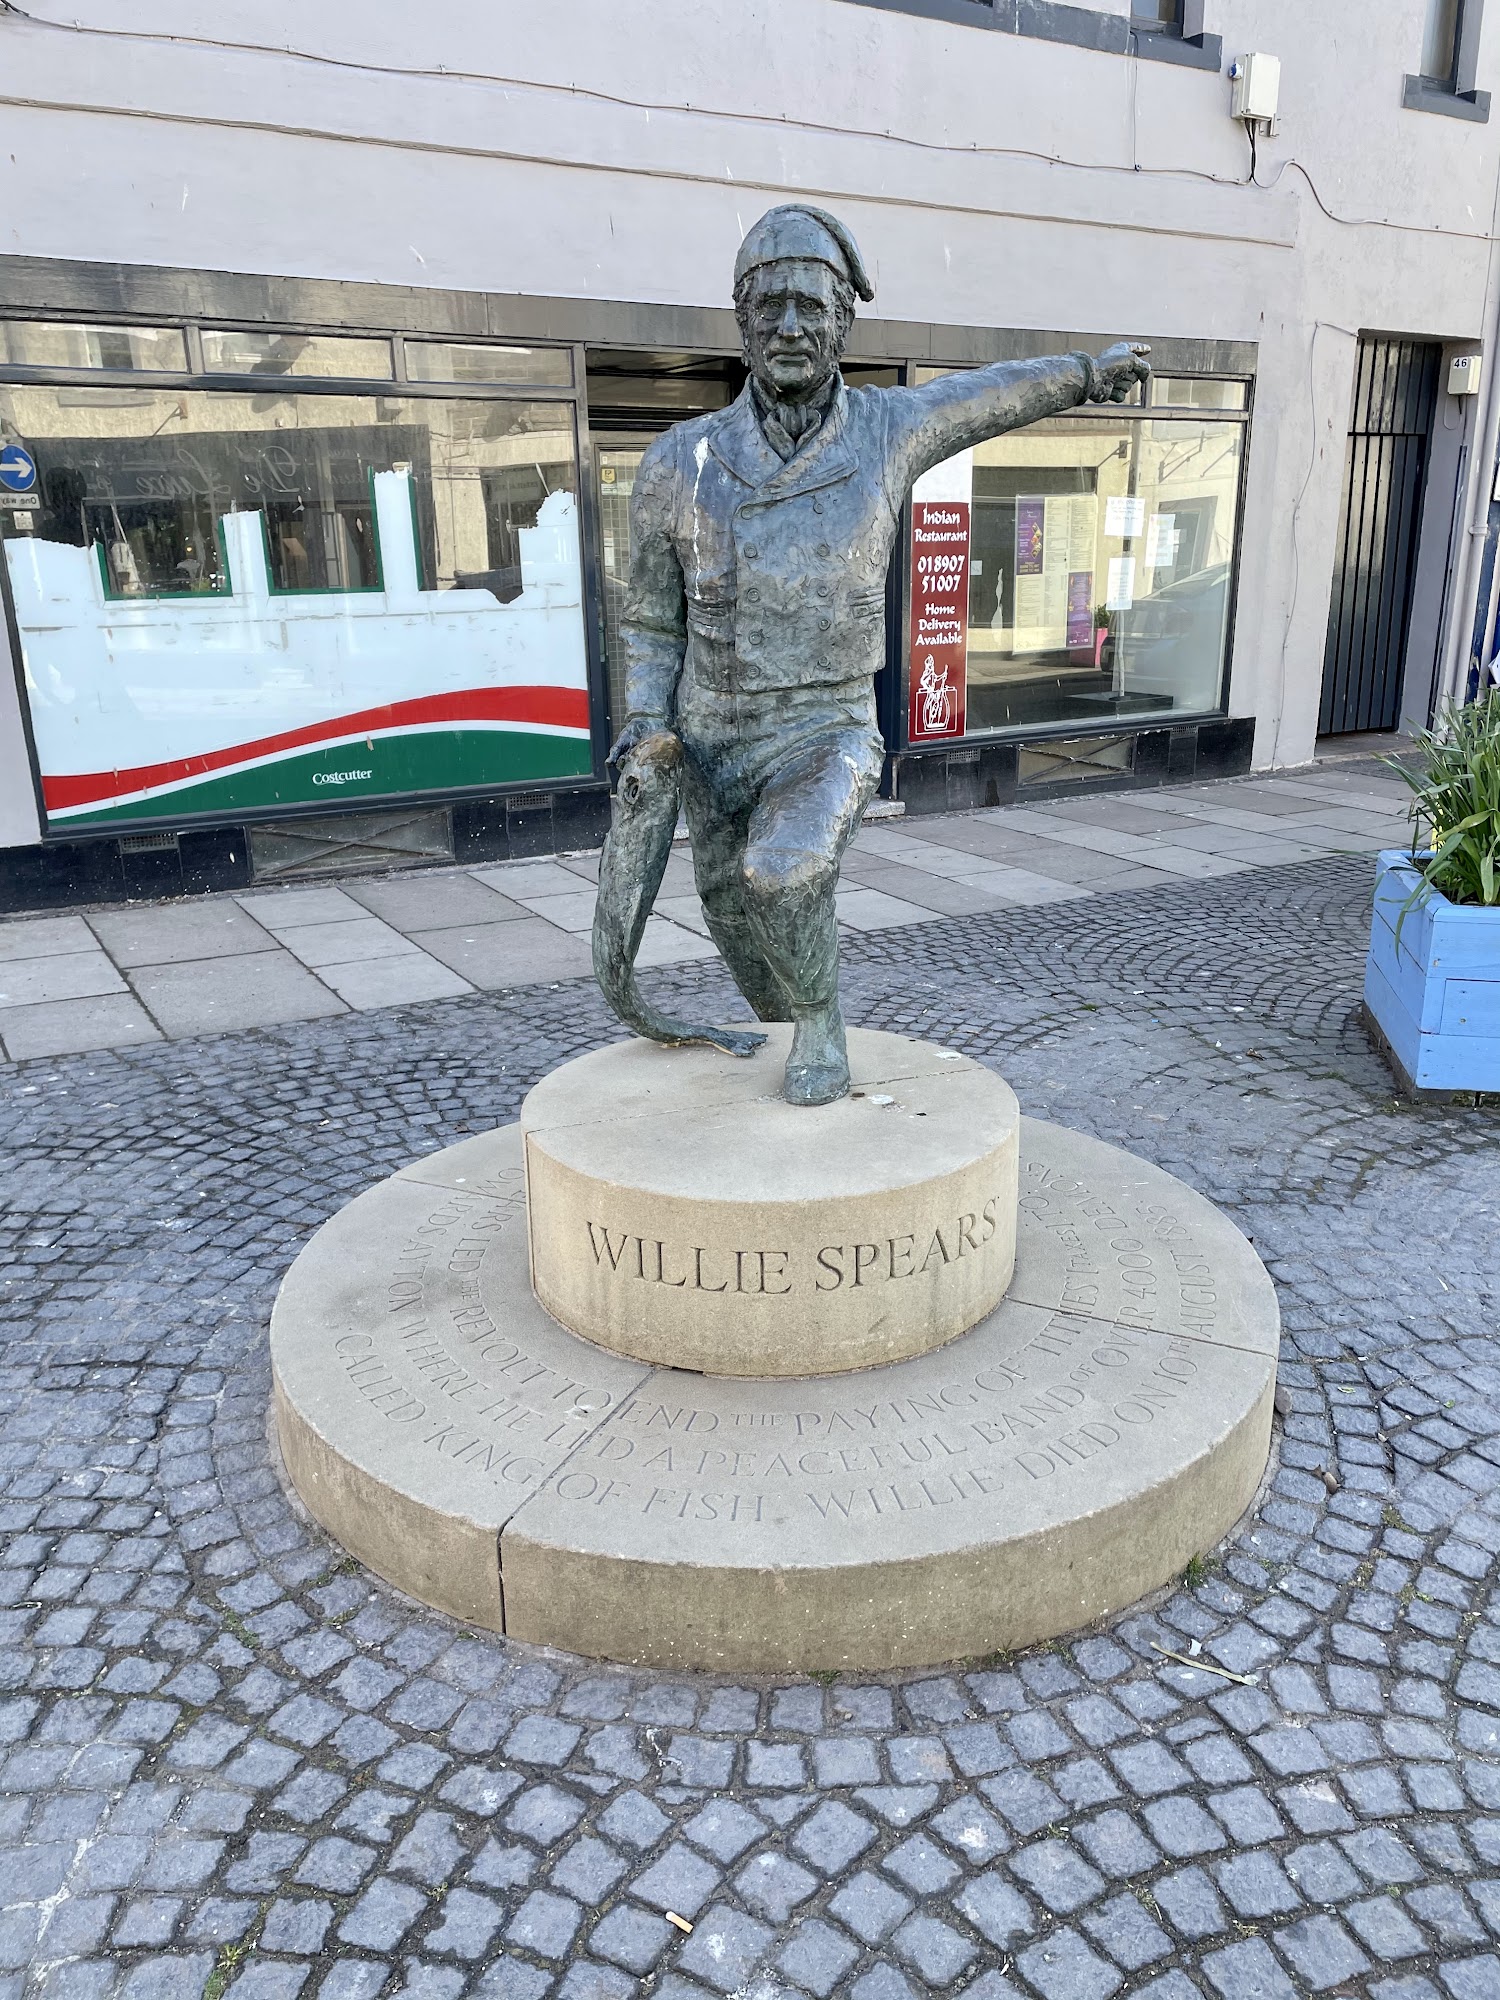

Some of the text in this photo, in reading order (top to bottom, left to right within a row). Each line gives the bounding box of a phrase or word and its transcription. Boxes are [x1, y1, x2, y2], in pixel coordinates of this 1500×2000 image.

[1454, 358, 1467, 368] 46
[923, 508, 960, 525] Indian
[914, 528, 967, 542] Restaurant
[917, 555, 965, 573] 018907
[921, 575, 961, 594] 51007
[918, 618, 961, 631] Delivery
[925, 603, 956, 615] Home
[915, 632, 962, 646] Available
[312, 769, 373, 785] Costcutter
[1018, 1196, 1063, 1221] TO
[448, 1237, 491, 1273] LED
[586, 1197, 997, 1296] WILLIE SPEARS
[388, 1238, 436, 1313] AYTON
[1110, 1238, 1157, 1299] 4000
[461, 1276, 480, 1300] THE
[450, 1304, 557, 1384] REVOLT
[1091, 1306, 1156, 1367] OVER
[397, 1318, 489, 1402] WHERE
[975, 1357, 1029, 1392] OF
[1069, 1363, 1096, 1382] OF
[335, 1333, 426, 1423] CALLED
[556, 1472, 631, 1506] OF
[804, 1466, 1005, 1519] WILLIE
[1014, 1422, 1120, 1480] DIED
[1113, 1382, 1177, 1424] ON
[1170, 1250, 1217, 1339] AUGUST
[552, 1377, 613, 1412] TO
[477, 1398, 544, 1433] HE
[617, 1399, 719, 1433] END
[731, 1413, 785, 1426] THE
[794, 1384, 979, 1436] PAYING
[970, 1384, 1085, 1445] BAND
[543, 1422, 635, 1460] LED
[696, 1433, 968, 1477] PEACEFUL
[641, 1446, 674, 1472] A
